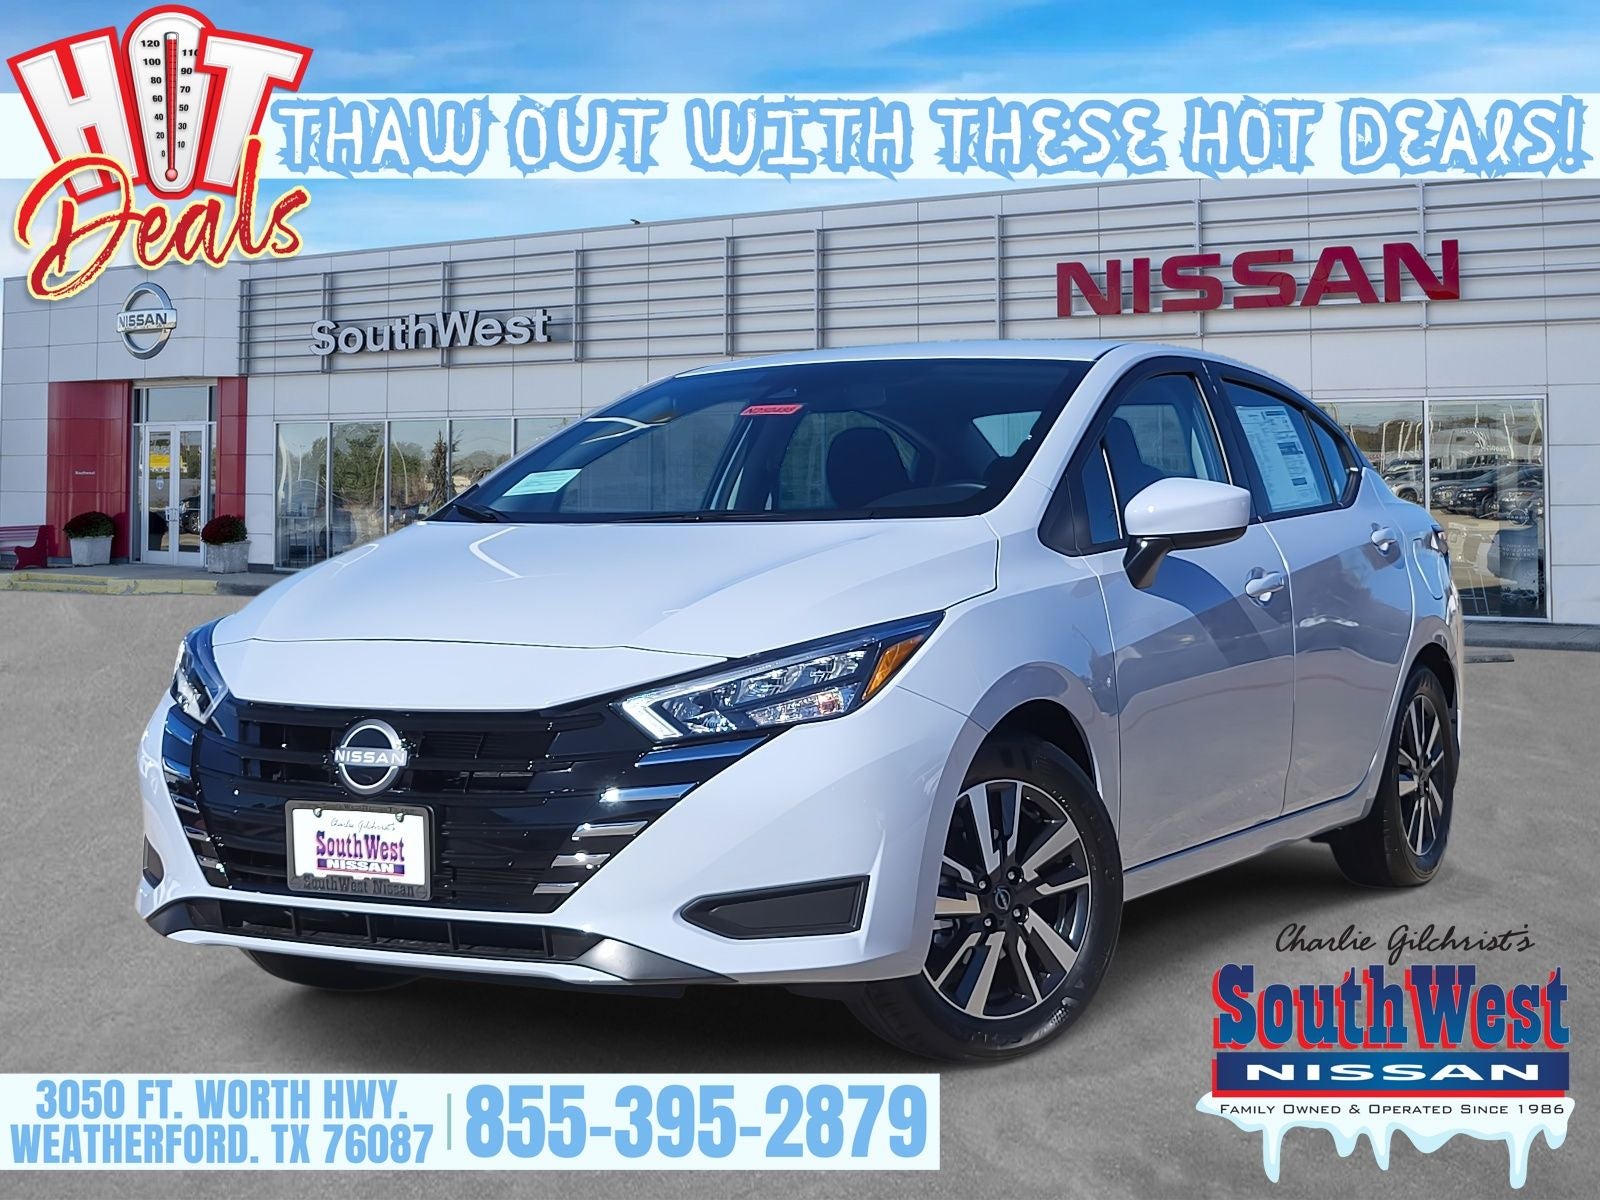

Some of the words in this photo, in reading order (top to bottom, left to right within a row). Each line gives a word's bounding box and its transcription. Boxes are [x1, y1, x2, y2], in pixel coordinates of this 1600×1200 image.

[1057, 239, 1461, 317] NISSAN
[118, 312, 168, 329] NISSAN
[308, 308, 552, 357] SouthWest
[334, 748, 406, 765] NISSAN
[315, 829, 405, 863] SouthWest
[325, 858, 396, 874] NISSAN
[302, 872, 369, 894] SouthWest
[371, 877, 416, 898] Nissan
